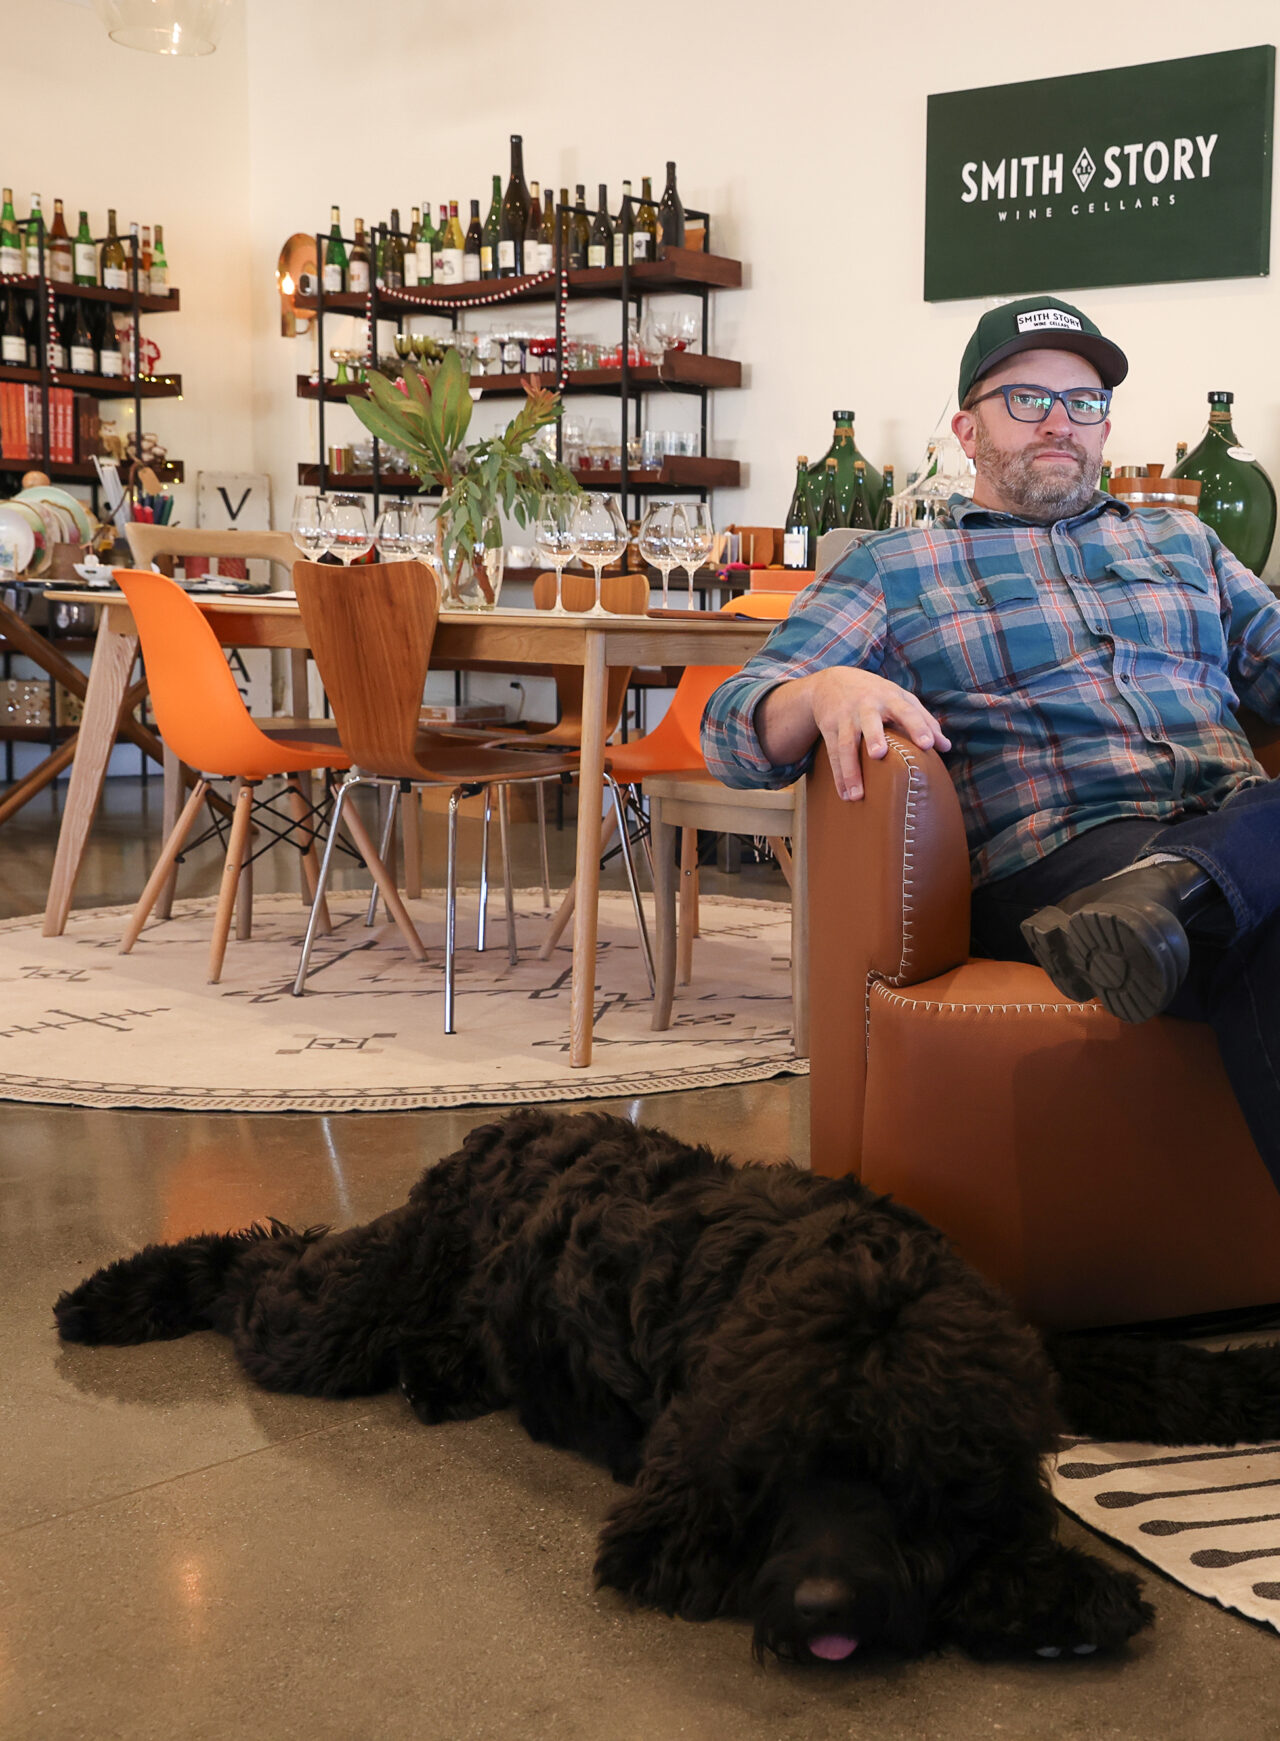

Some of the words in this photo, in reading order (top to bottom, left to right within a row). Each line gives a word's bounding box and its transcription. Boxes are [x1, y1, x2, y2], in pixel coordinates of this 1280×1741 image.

[961, 153, 1064, 203] SMITH
[1103, 133, 1219, 189] STORY
[998, 207, 1053, 222] WINE
[1071, 194, 1176, 216] CELLARS
[1019, 313, 1049, 324] SMITH
[1053, 313, 1079, 327] STORY
